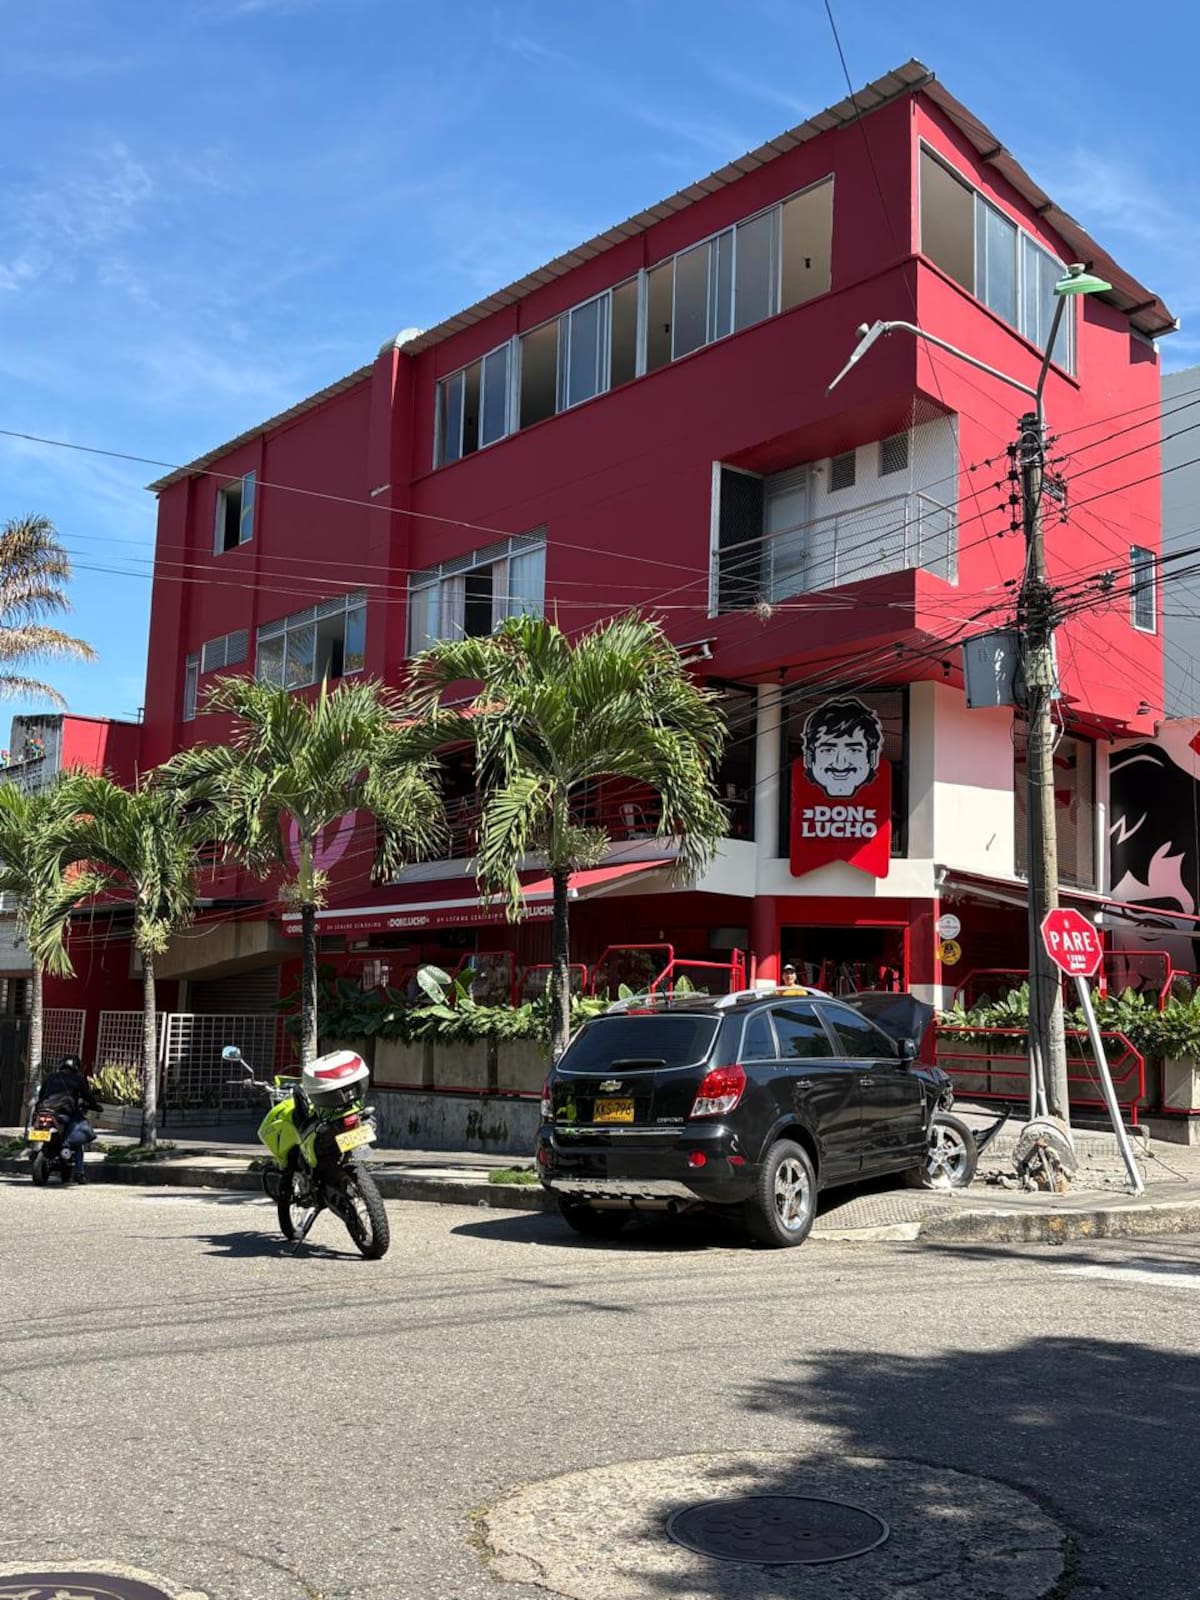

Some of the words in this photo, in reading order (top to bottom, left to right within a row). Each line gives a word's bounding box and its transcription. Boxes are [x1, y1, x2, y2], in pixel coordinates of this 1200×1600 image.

[813, 805, 865, 821] DON
[801, 822, 878, 838] LUCHO
[1049, 930, 1095, 952] PARE
